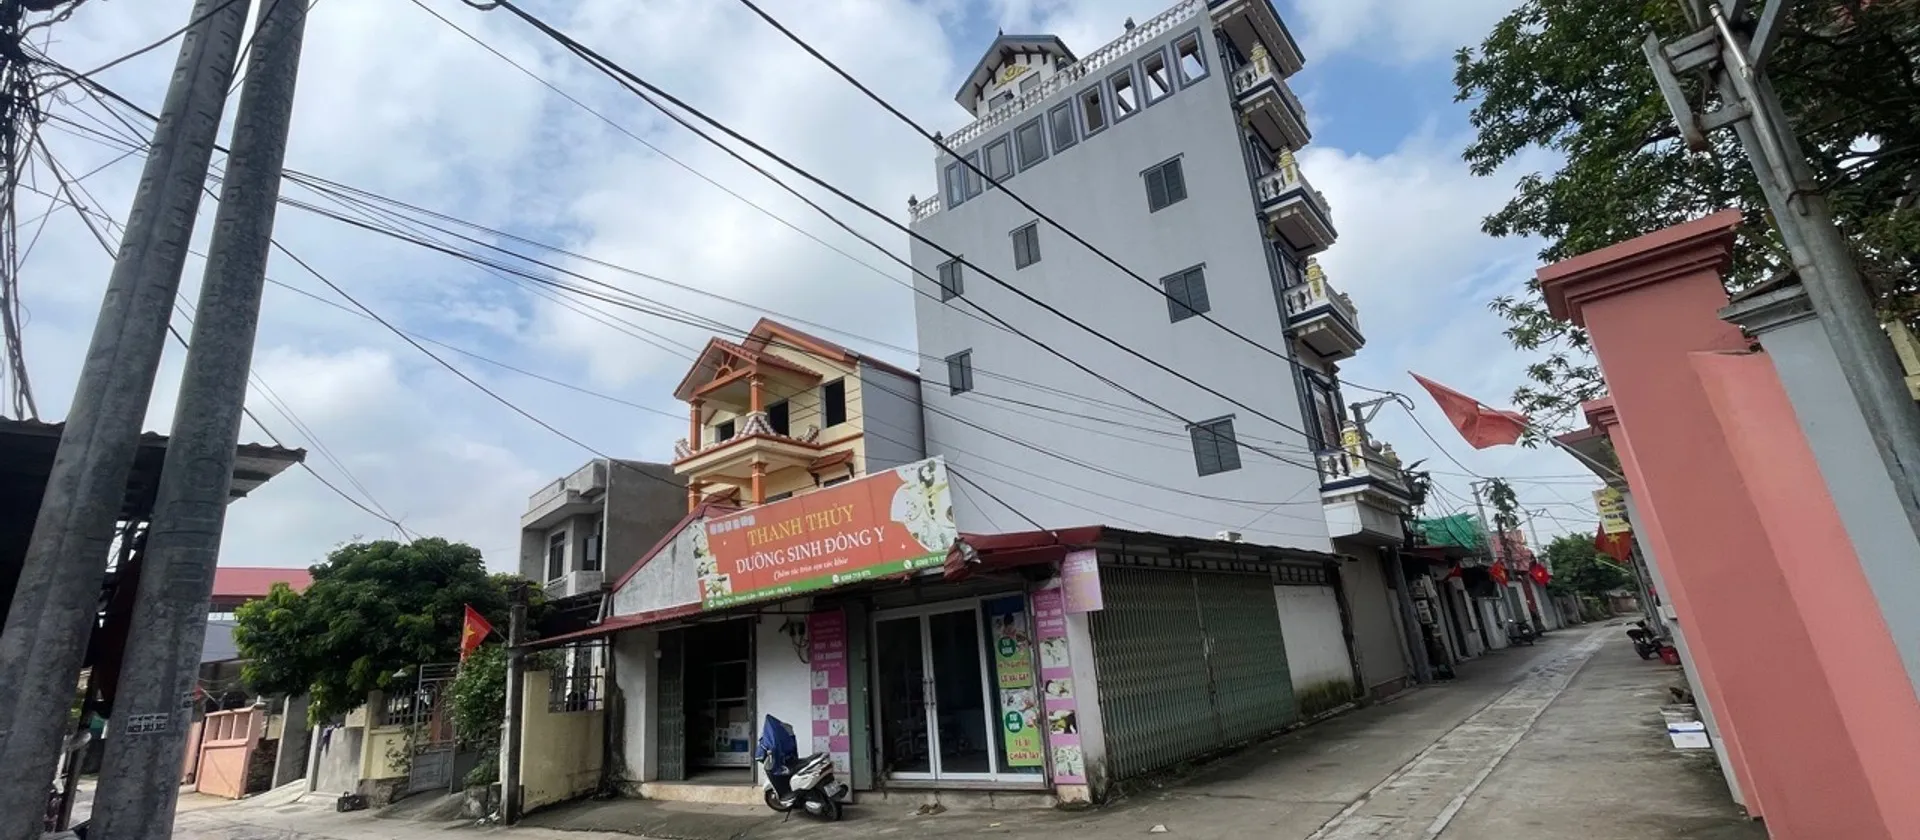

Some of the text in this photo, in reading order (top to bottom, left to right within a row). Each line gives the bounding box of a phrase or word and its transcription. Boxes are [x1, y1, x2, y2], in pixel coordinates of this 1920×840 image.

[736, 525, 885, 574] DƯỠNG SINH ĐÔNG Y
[747, 517, 803, 546] THANH
